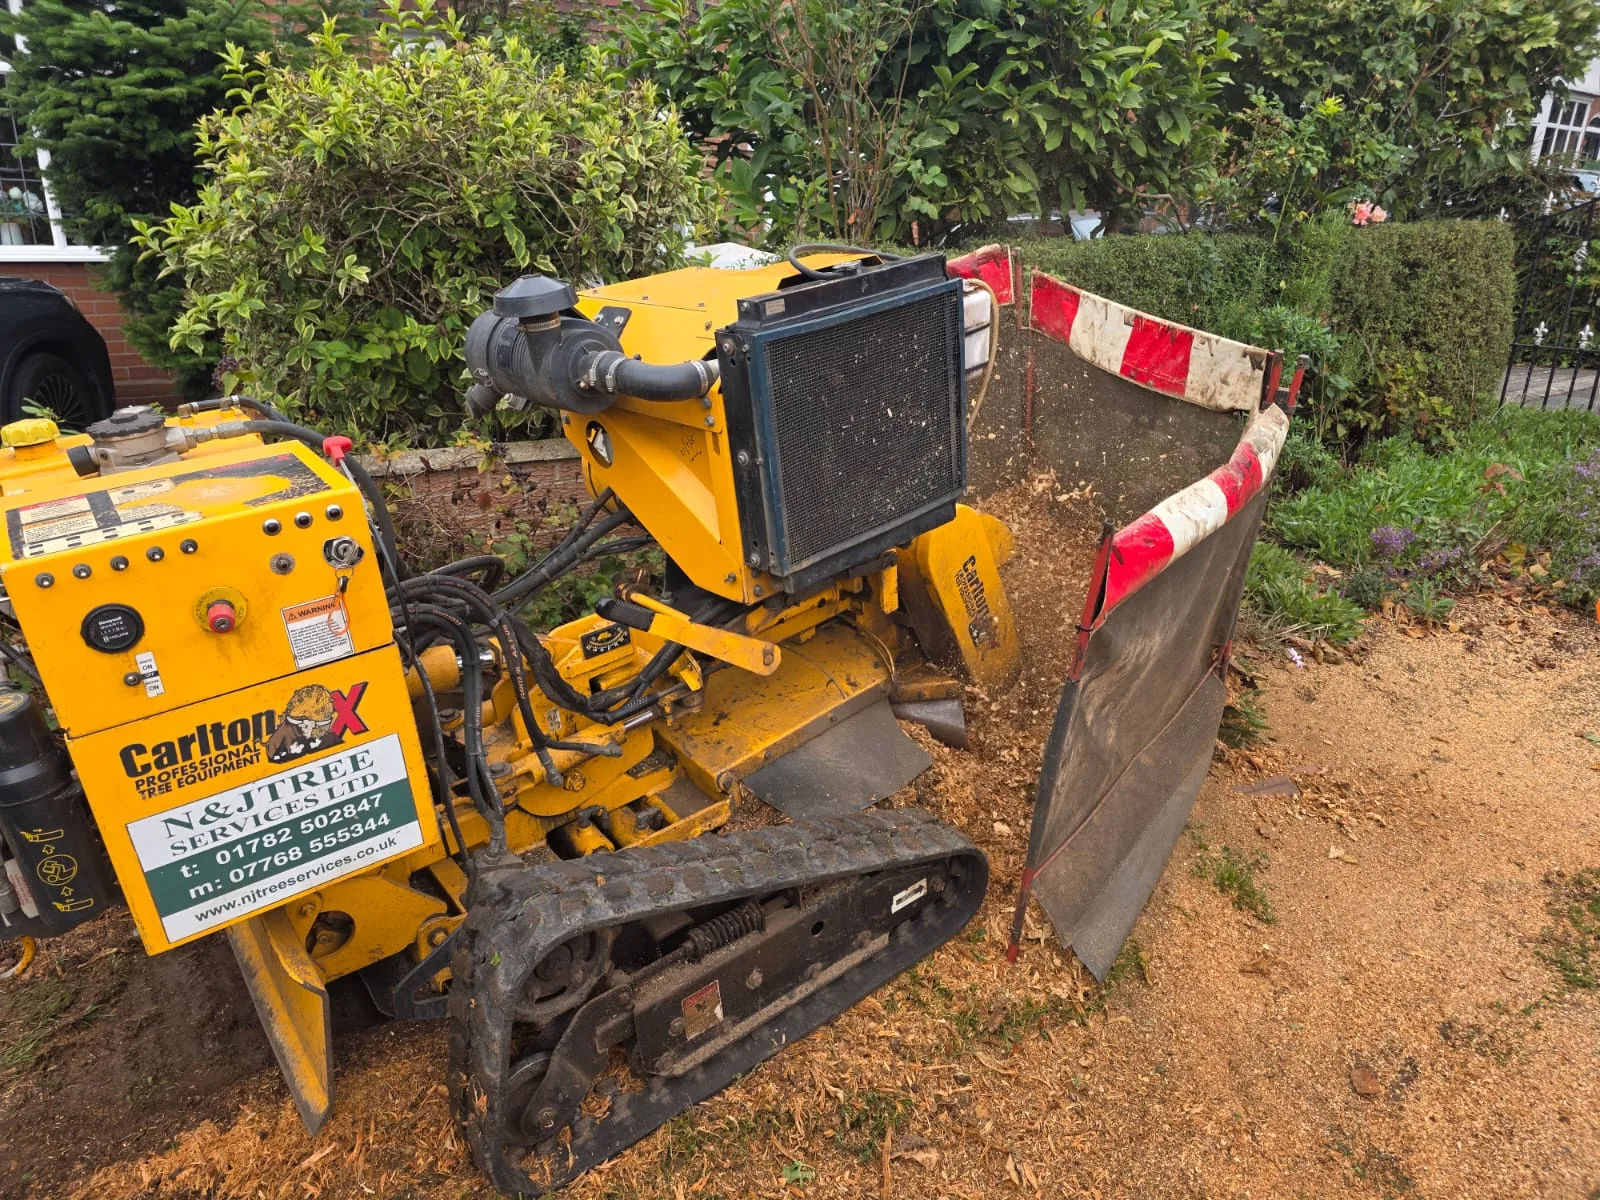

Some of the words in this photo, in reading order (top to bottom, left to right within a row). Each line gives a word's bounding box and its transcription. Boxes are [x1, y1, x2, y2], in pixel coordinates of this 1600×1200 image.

[297, 601, 336, 618] WARNING
[962, 555, 990, 617] Carlton
[149, 684, 160, 692] ON
[119, 709, 276, 778] Carlton
[330, 681, 371, 738] X
[134, 741, 261, 791] PROFESSIONAL
[138, 782, 173, 801] TREE
[177, 752, 261, 789] EQUIPMENT
[170, 793, 319, 857] SERVICES
[326, 773, 379, 802] LTD
[180, 863, 200, 879] t:
[216, 827, 293, 865] 01782
[300, 793, 382, 834] 502847
[189, 877, 222, 899] m:
[229, 847, 302, 883] 07768
[309, 813, 391, 853] 555344
[195, 836, 397, 922] www.njtreeservices.co.uk
